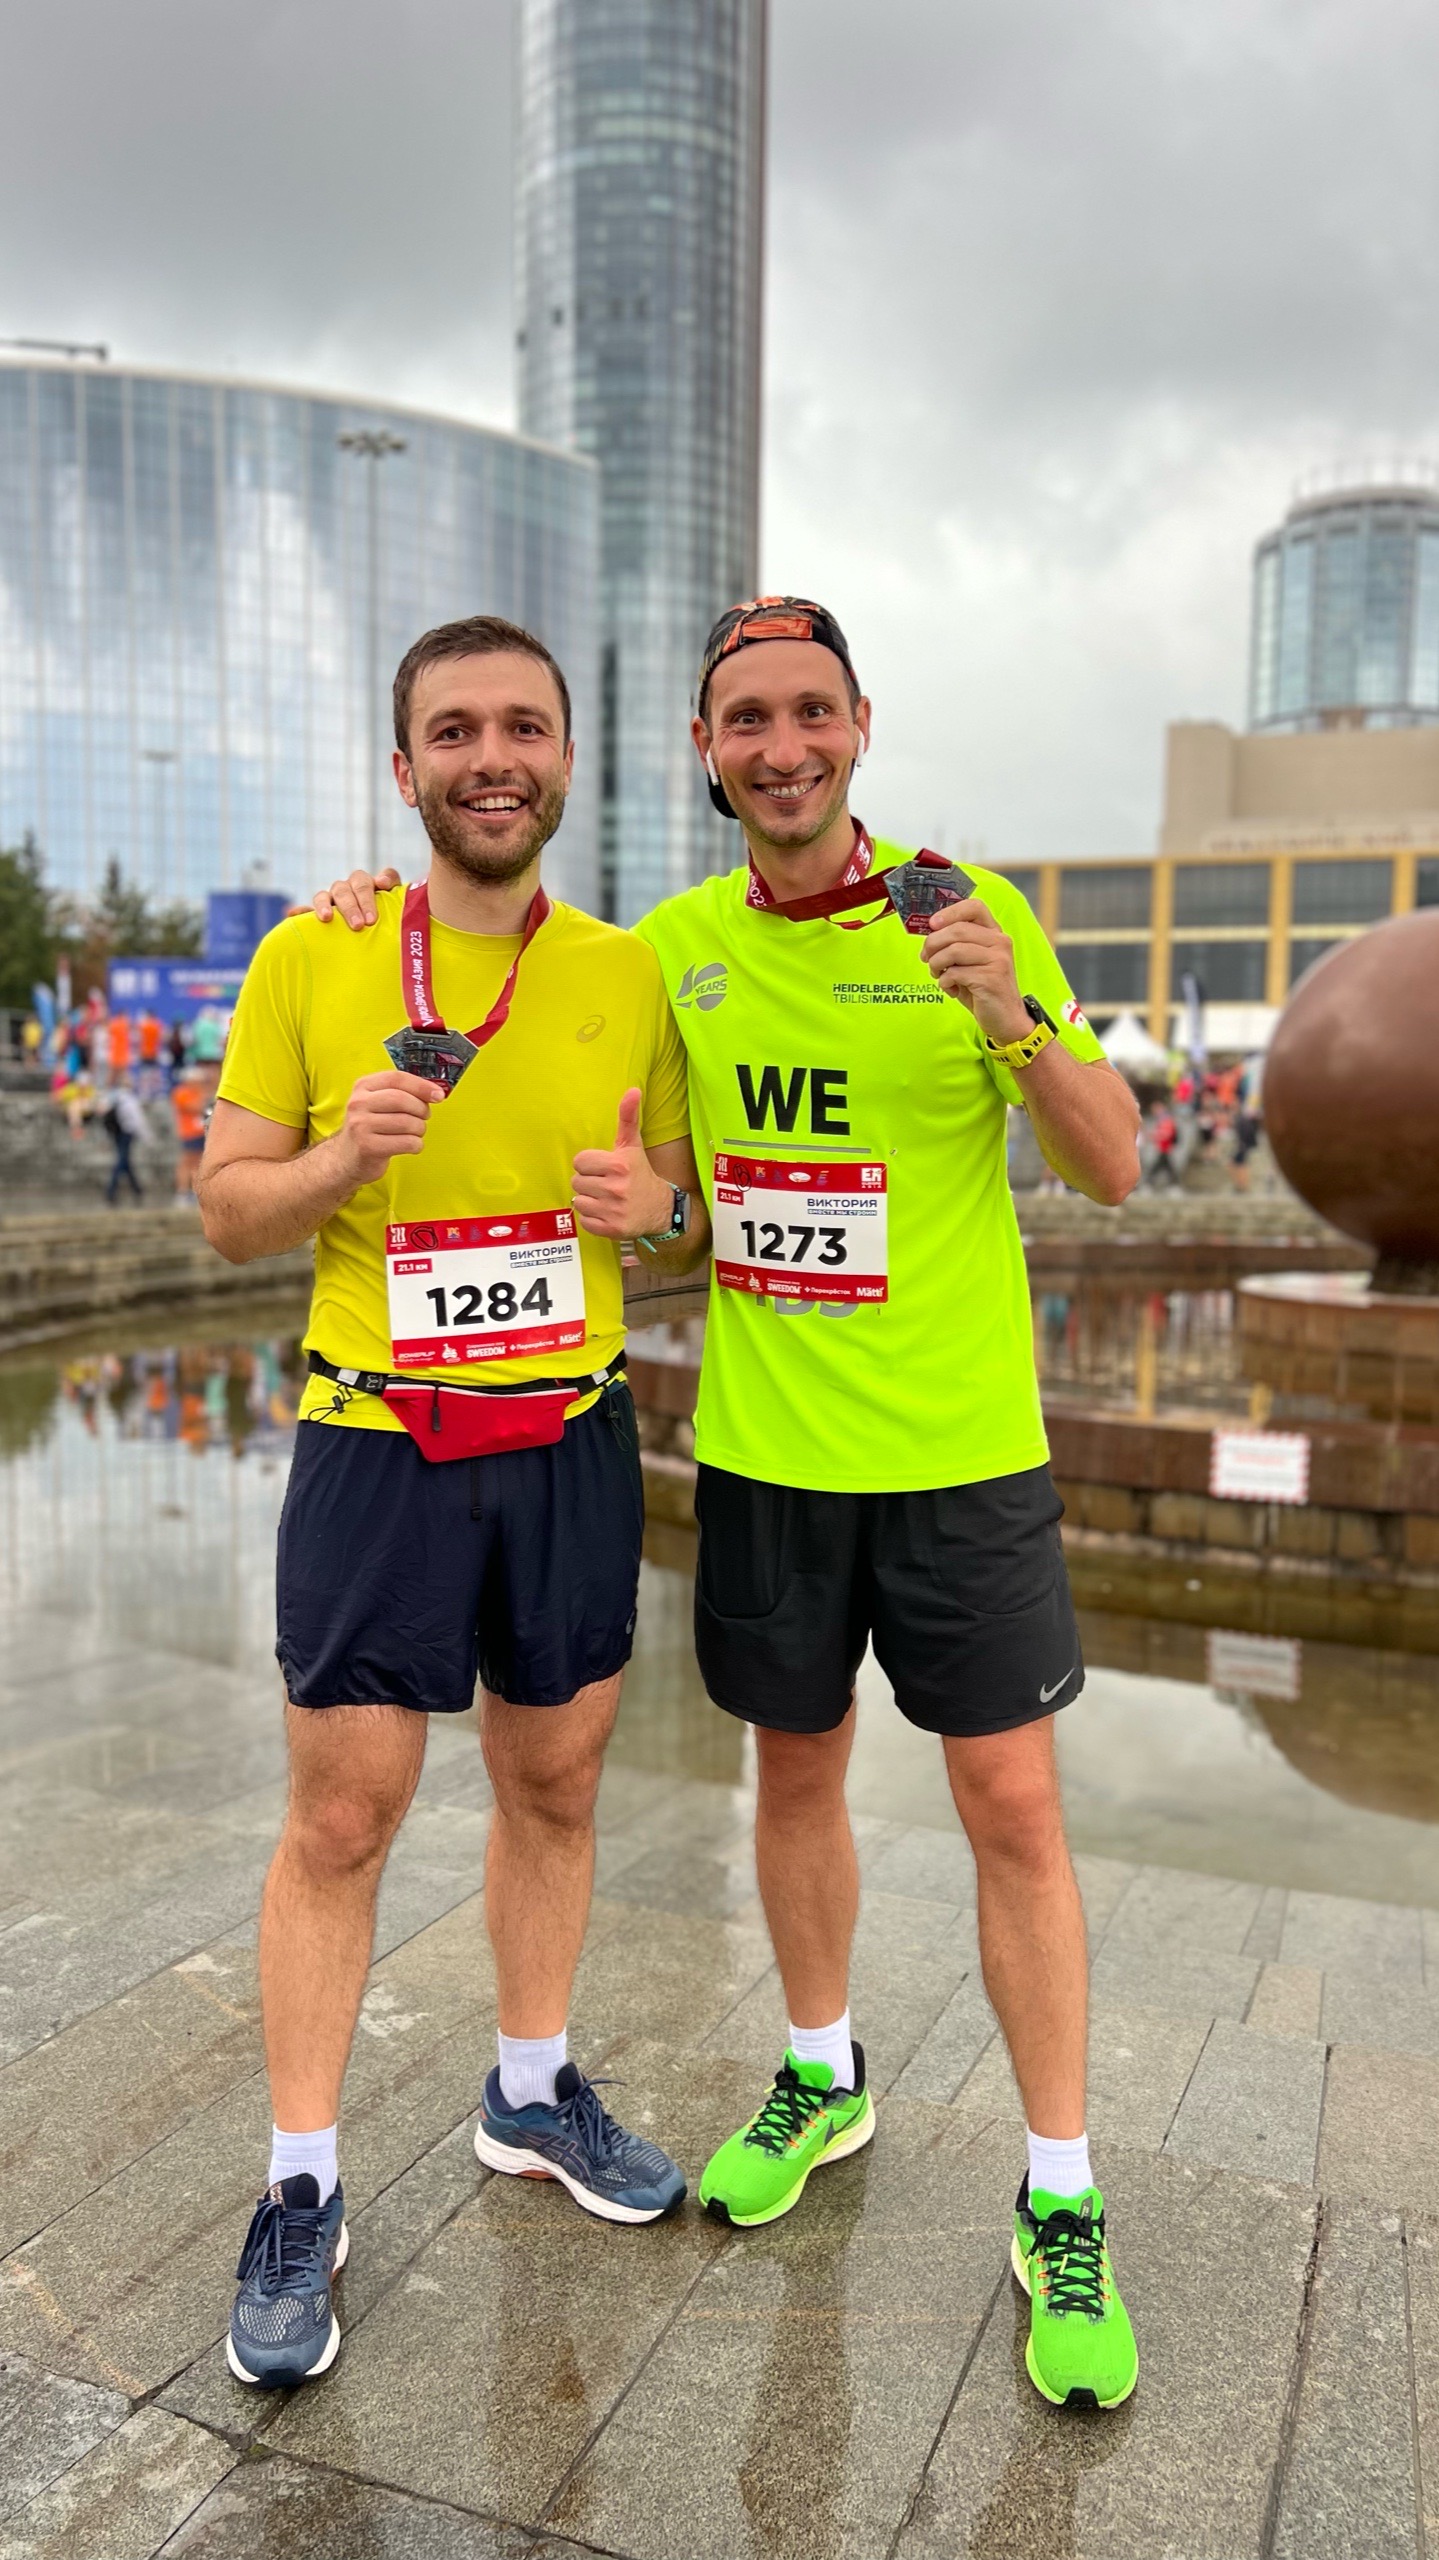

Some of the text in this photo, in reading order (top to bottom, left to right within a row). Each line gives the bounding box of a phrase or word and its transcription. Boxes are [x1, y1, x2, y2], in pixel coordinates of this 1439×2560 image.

[410, 931, 423, 957] 2023
[695, 978, 728, 995] YEARS
[833, 983, 944, 993] HEIDELBERGCEMEN
[736, 1064, 850, 1136] WE
[807, 1198, 877, 1208] ВИКТОРИЯ
[741, 1220, 847, 1266] 1273
[509, 1245, 573, 1261] ВИКТОРИЯ
[398, 1263, 414, 1272] 21.1
[426, 1277, 553, 1327] 1284
